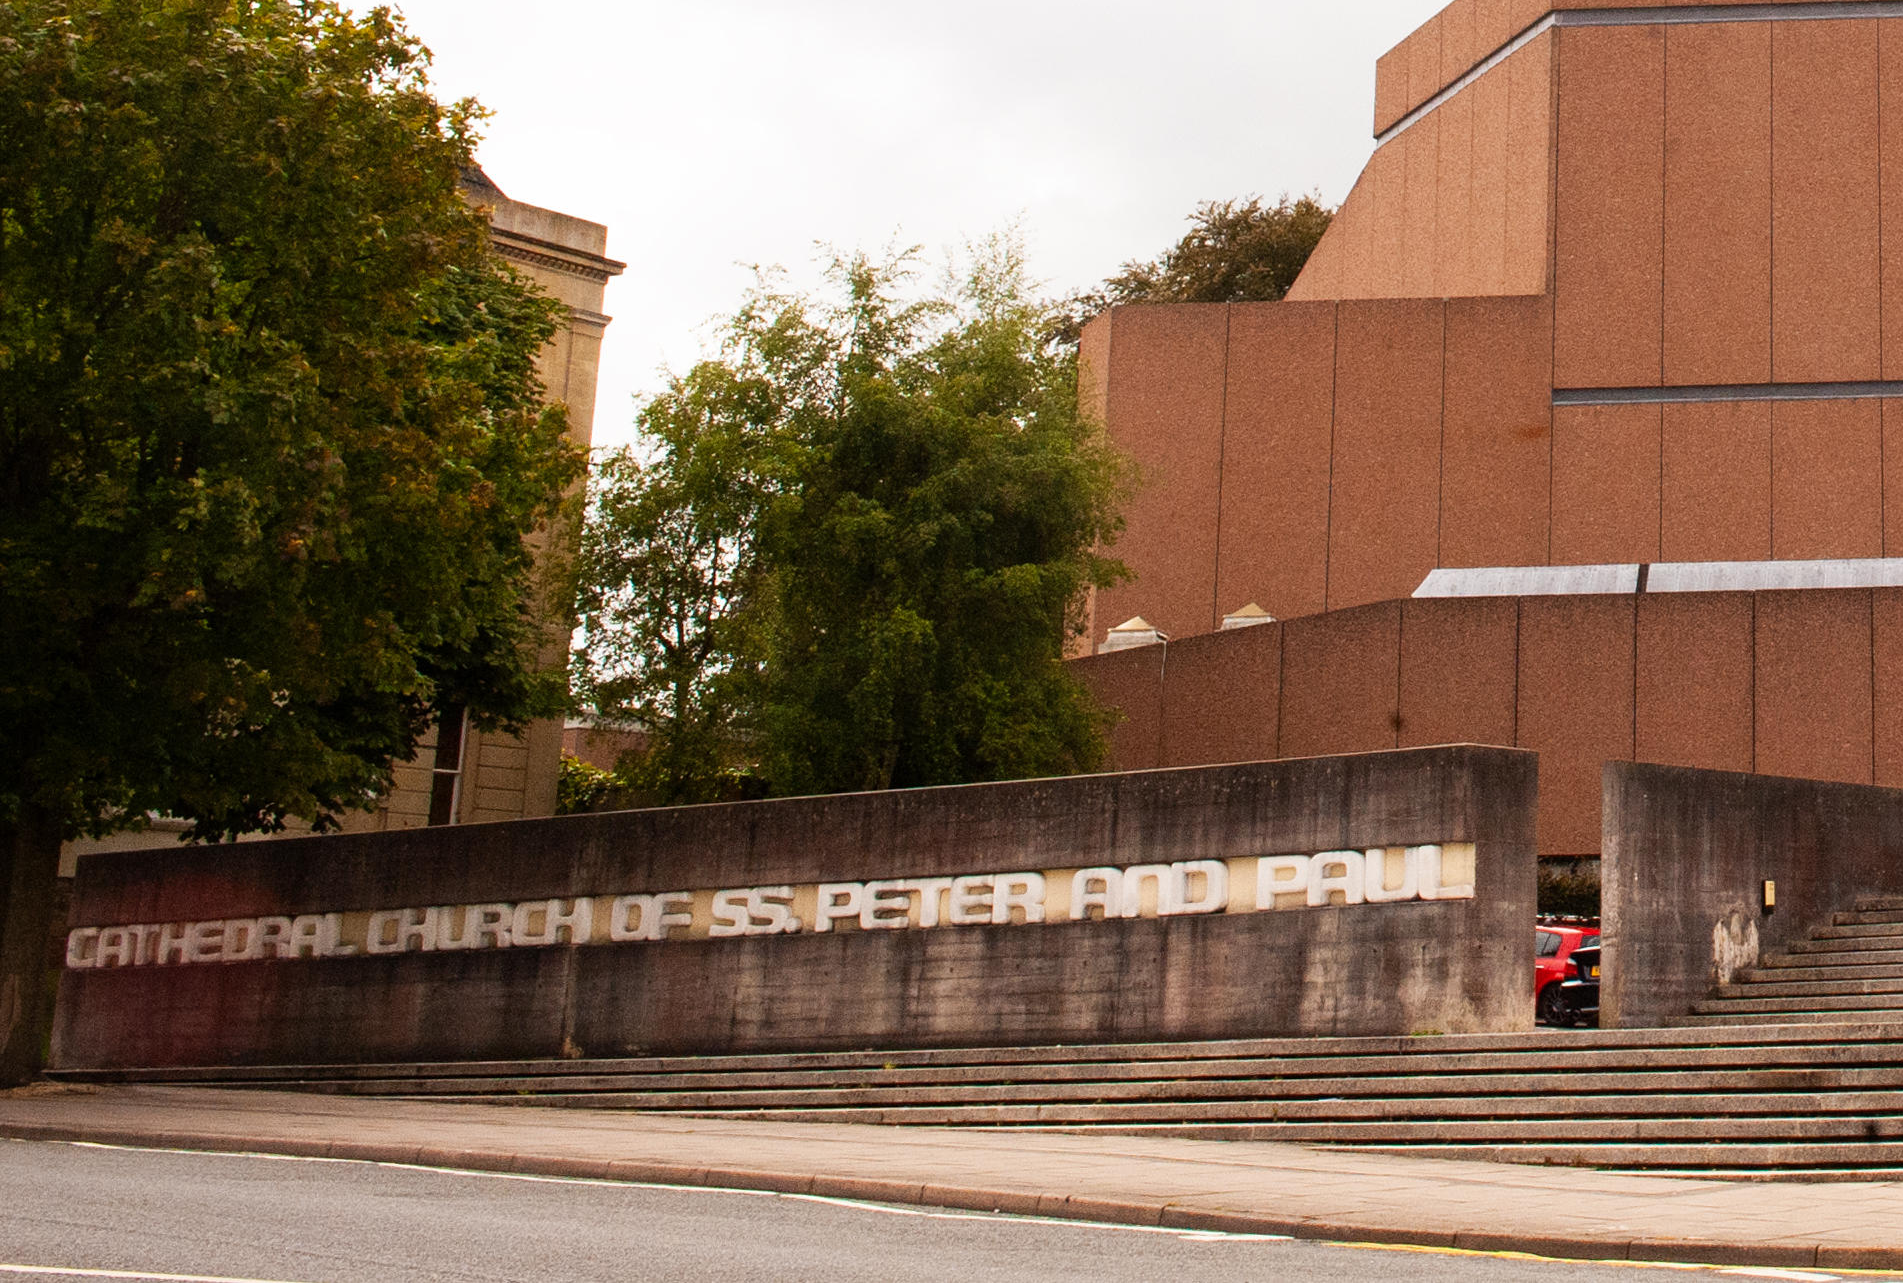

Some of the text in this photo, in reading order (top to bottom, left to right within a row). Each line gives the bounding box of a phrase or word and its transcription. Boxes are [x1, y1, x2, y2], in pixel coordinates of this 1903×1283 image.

[66, 844, 1475, 968] CATHEDRAL CHURCH OF SS. PETER AND PAUL
